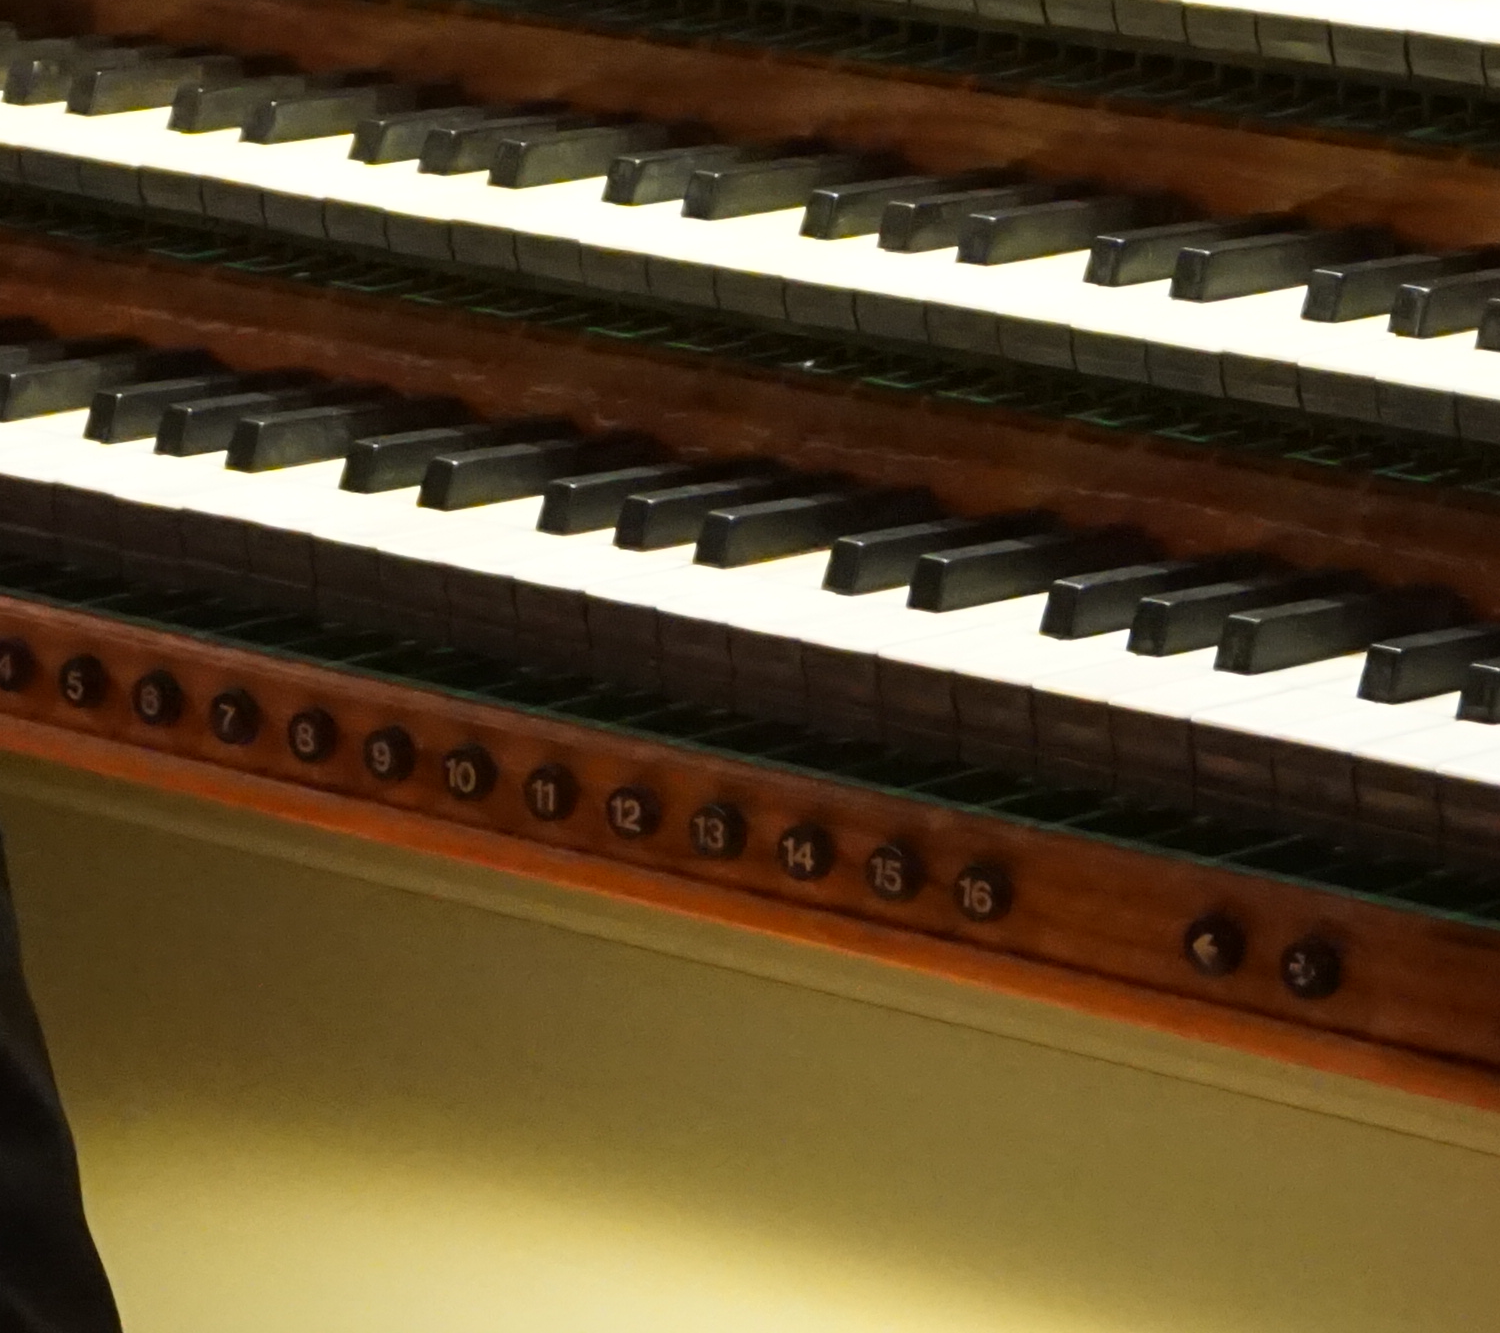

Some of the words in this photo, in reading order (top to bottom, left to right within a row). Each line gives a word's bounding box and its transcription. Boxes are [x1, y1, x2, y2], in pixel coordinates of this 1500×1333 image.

[66, 670, 84, 701] 5
[219, 703, 236, 732] 7
[295, 721, 316, 753] 8
[372, 741, 391, 772] 9
[445, 759, 477, 793] 10
[532, 780, 555, 812] 11
[612, 797, 641, 832] 12
[693, 816, 725, 850] 13
[782, 837, 815, 872] 14
[871, 856, 902, 893] 15
[960, 877, 993, 913] 16
